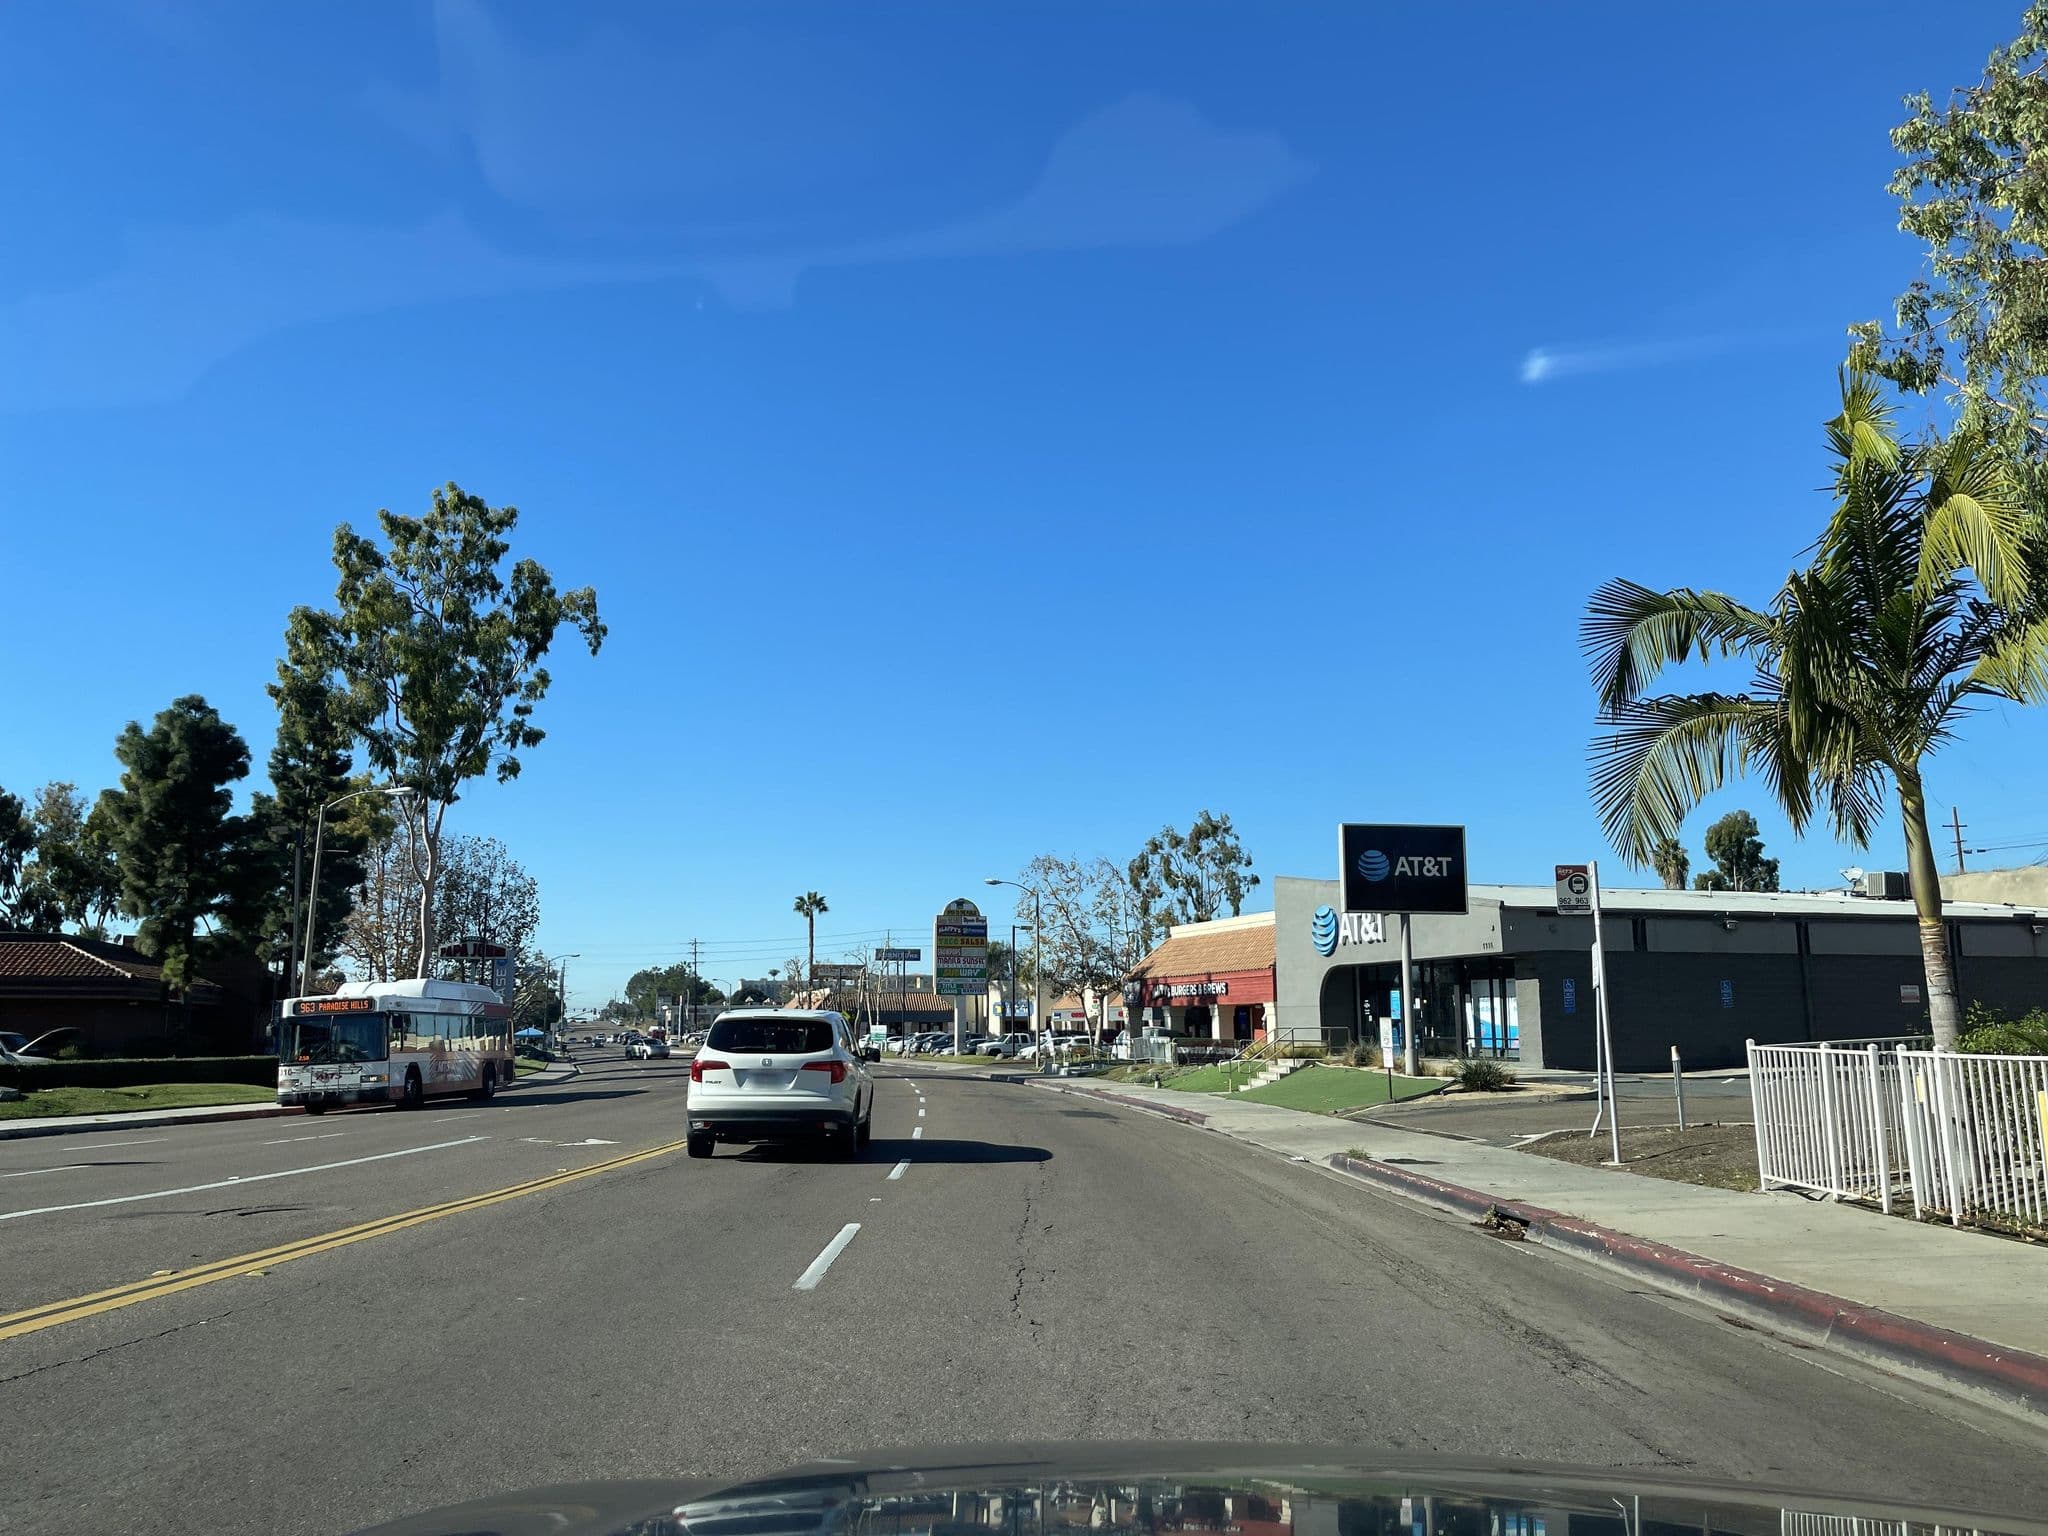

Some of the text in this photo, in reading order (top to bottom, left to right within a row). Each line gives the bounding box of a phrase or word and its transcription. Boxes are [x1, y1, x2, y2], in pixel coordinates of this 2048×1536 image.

[1395, 856, 1452, 877] AT&T
[1575, 897, 1589, 905] 963
[1339, 913, 1384, 944] AT&T
[961, 937, 985, 946] SALSA
[943, 968, 981, 977] SUBWAY
[1171, 984, 1197, 996] BURGERS
[1203, 982, 1226, 995] BREWS
[300, 1000, 369, 1013] 963 PARADISE HILLS
